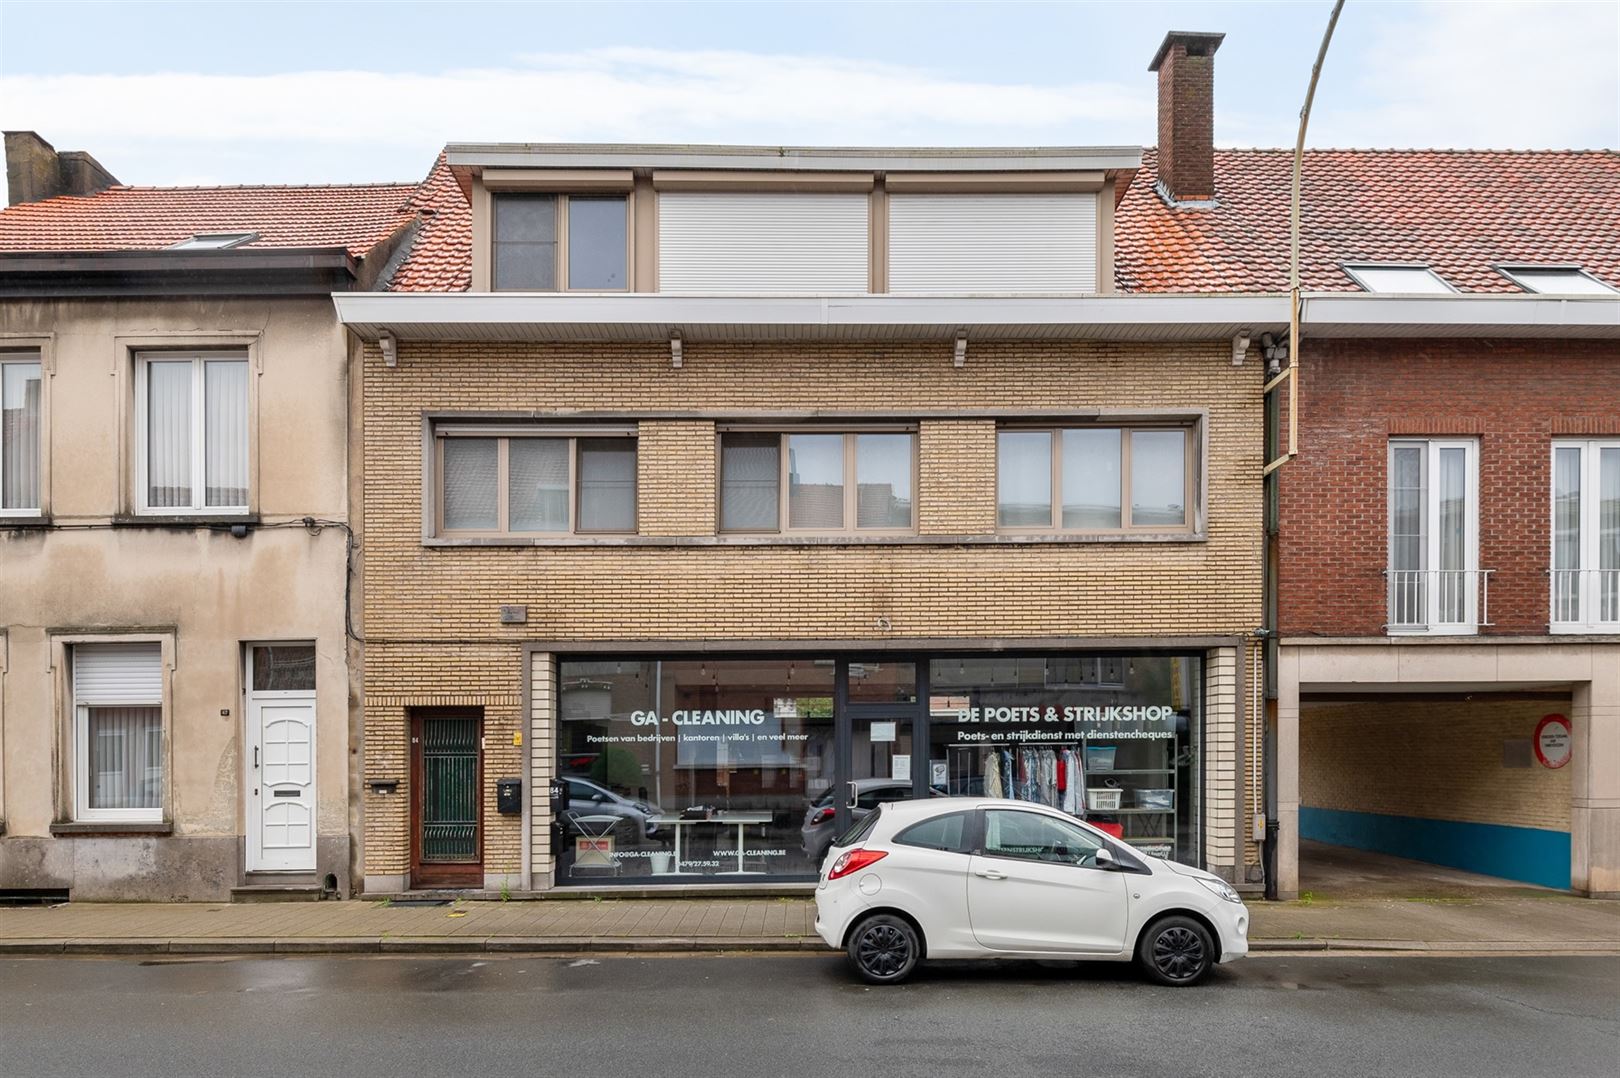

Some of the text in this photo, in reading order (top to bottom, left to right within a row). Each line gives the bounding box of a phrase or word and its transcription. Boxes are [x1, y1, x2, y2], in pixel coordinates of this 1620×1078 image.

[630, 710, 658, 726] GA
[672, 710, 765, 726] CLEANING
[958, 706, 1172, 722] DE POETS & STRIJKSHOP
[637, 734, 676, 743] bedrijven
[683, 734, 720, 742] kantoren
[728, 733, 750, 741] villa's
[958, 731, 989, 740] Poets-
[1006, 730, 1062, 742] strijkdienst
[1064, 732, 1084, 740] met
[1086, 730, 1172, 741] dienstencheques
